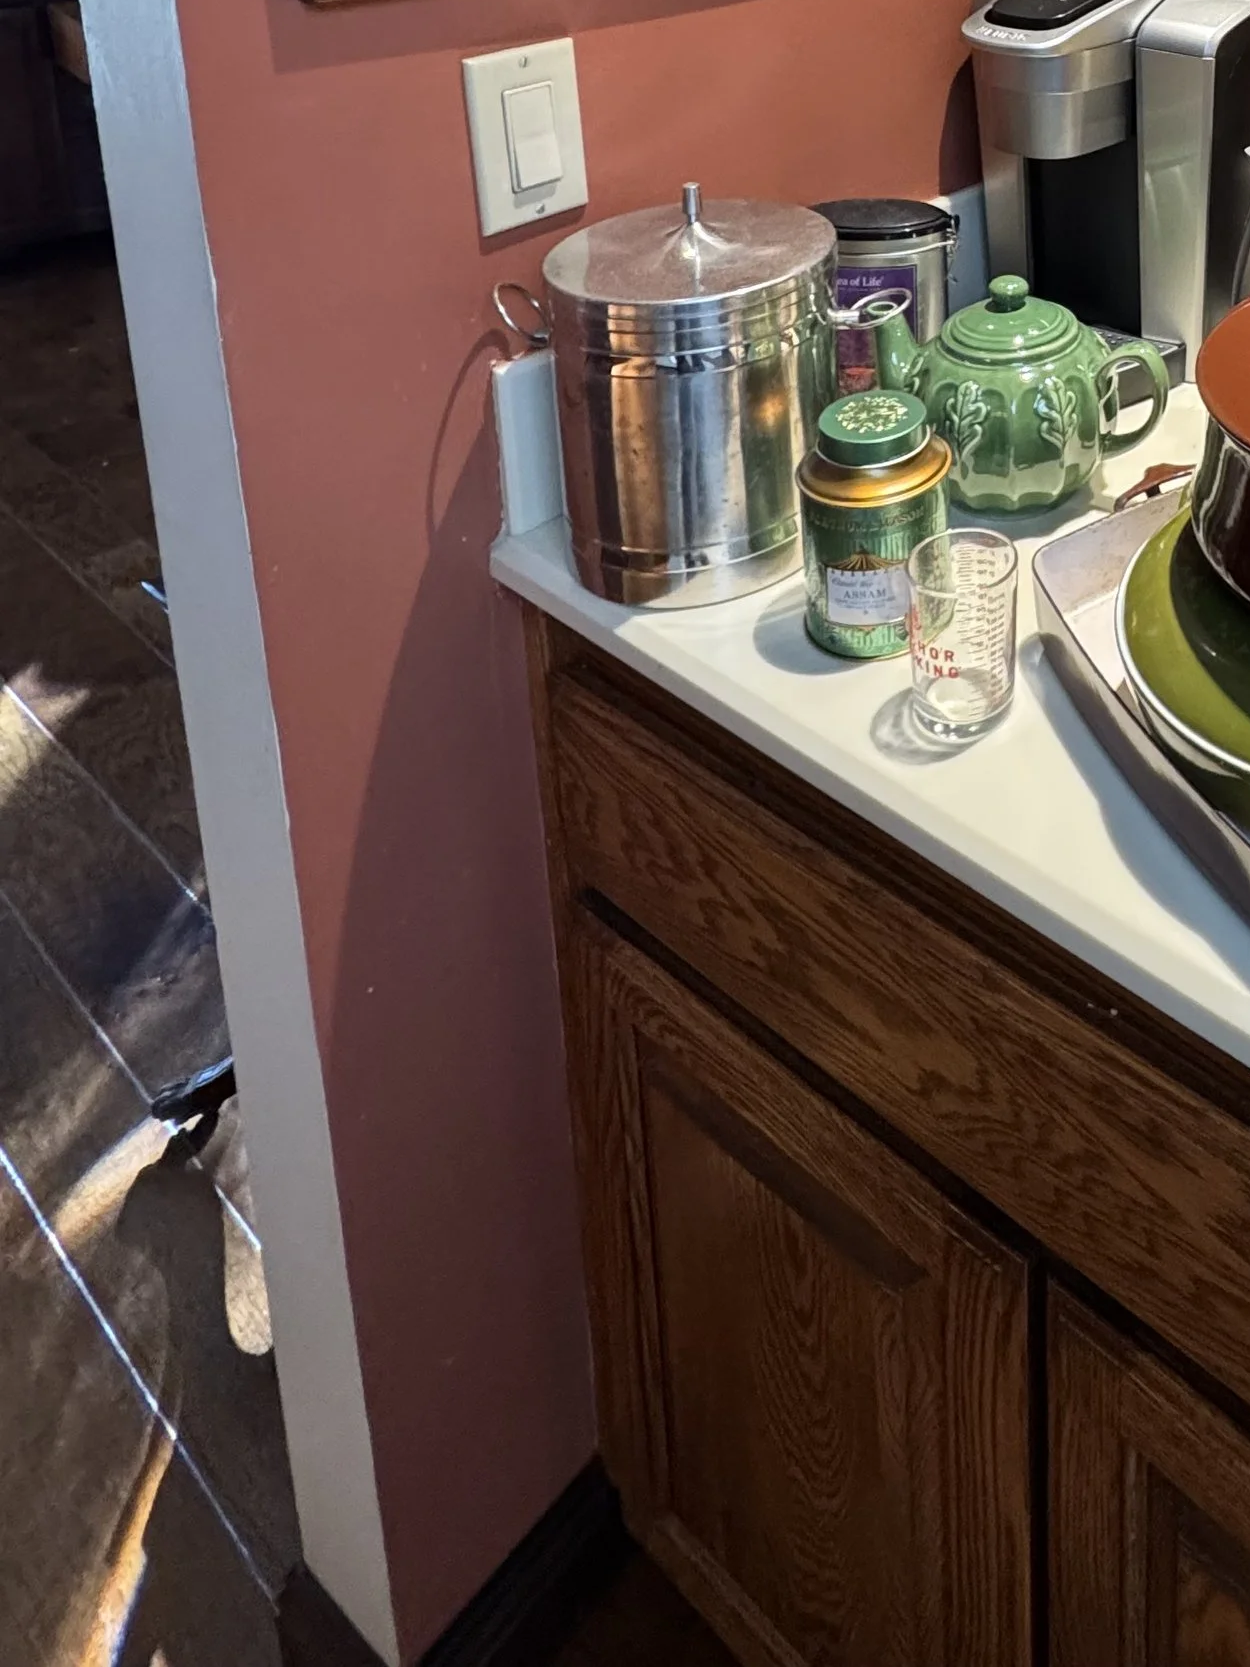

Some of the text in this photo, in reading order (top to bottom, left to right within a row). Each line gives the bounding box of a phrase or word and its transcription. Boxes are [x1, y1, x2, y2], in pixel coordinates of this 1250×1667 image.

[849, 275, 861, 287] of
[862, 275, 880, 287] Life
[844, 588, 886, 599] ASSAM
[916, 639, 955, 663] HOR
